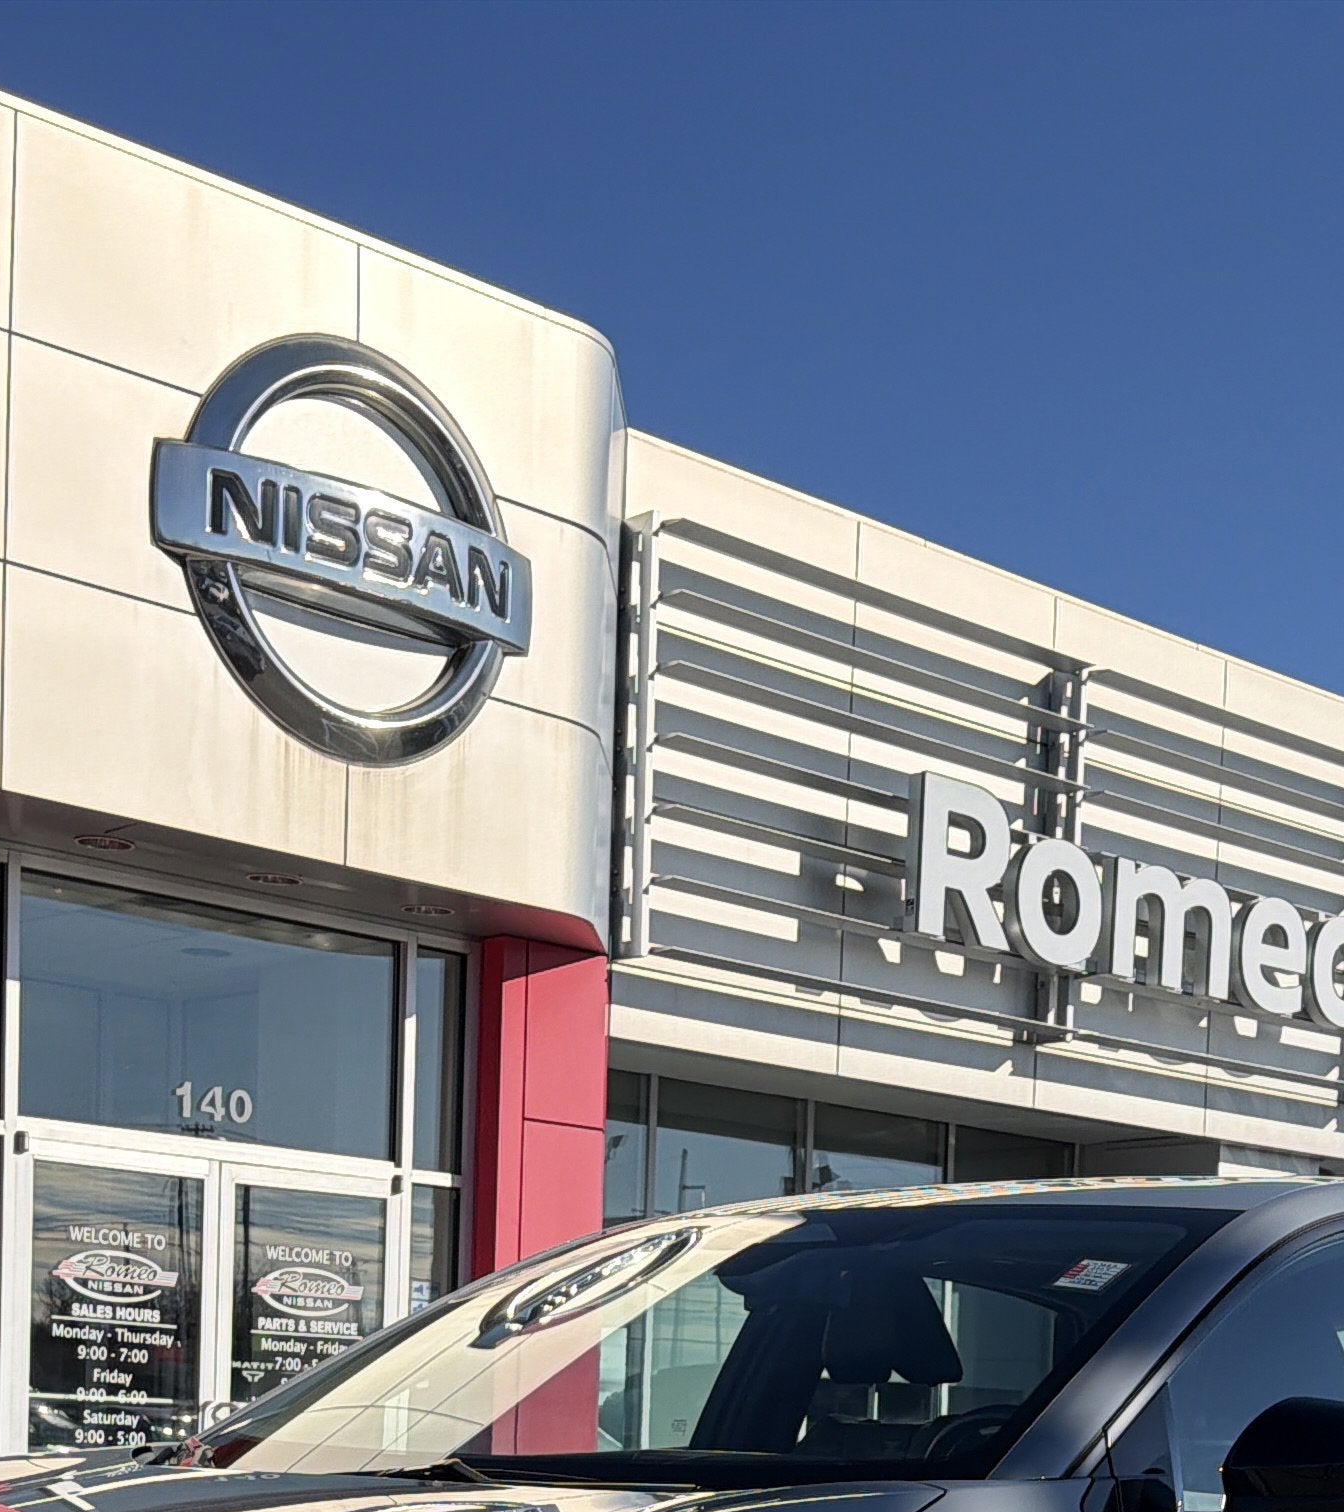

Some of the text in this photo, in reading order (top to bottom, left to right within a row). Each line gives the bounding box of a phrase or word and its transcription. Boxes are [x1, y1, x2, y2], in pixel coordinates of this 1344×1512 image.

[205, 467, 513, 624] NISSAN
[176, 1080, 253, 1124] 140
[69, 1225, 166, 1250] WELCOME TO
[266, 1245, 353, 1266] WELCOME TO
[76, 1253, 158, 1281] Romeo
[87, 1280, 144, 1294] NISSAN
[273, 1271, 345, 1295] Romeo
[283, 1295, 333, 1309] NISSAN
[71, 1302, 161, 1323] SALES HOURS
[51, 1323, 104, 1343] Monday
[115, 1328, 174, 1349] Thursday
[257, 1316, 358, 1336] PARTS & SERVICE
[77, 1344, 108, 1361] 9:00
[119, 1347, 149, 1364] 7:00
[260, 1337, 307, 1356] Monday
[275, 1356, 302, 1371] 7:00
[93, 1368, 133, 1387] Friday
[83, 1409, 140, 1428] Saturday
[75, 1428, 105, 1444] 9:00
[117, 1430, 146, 1446] 5:00
